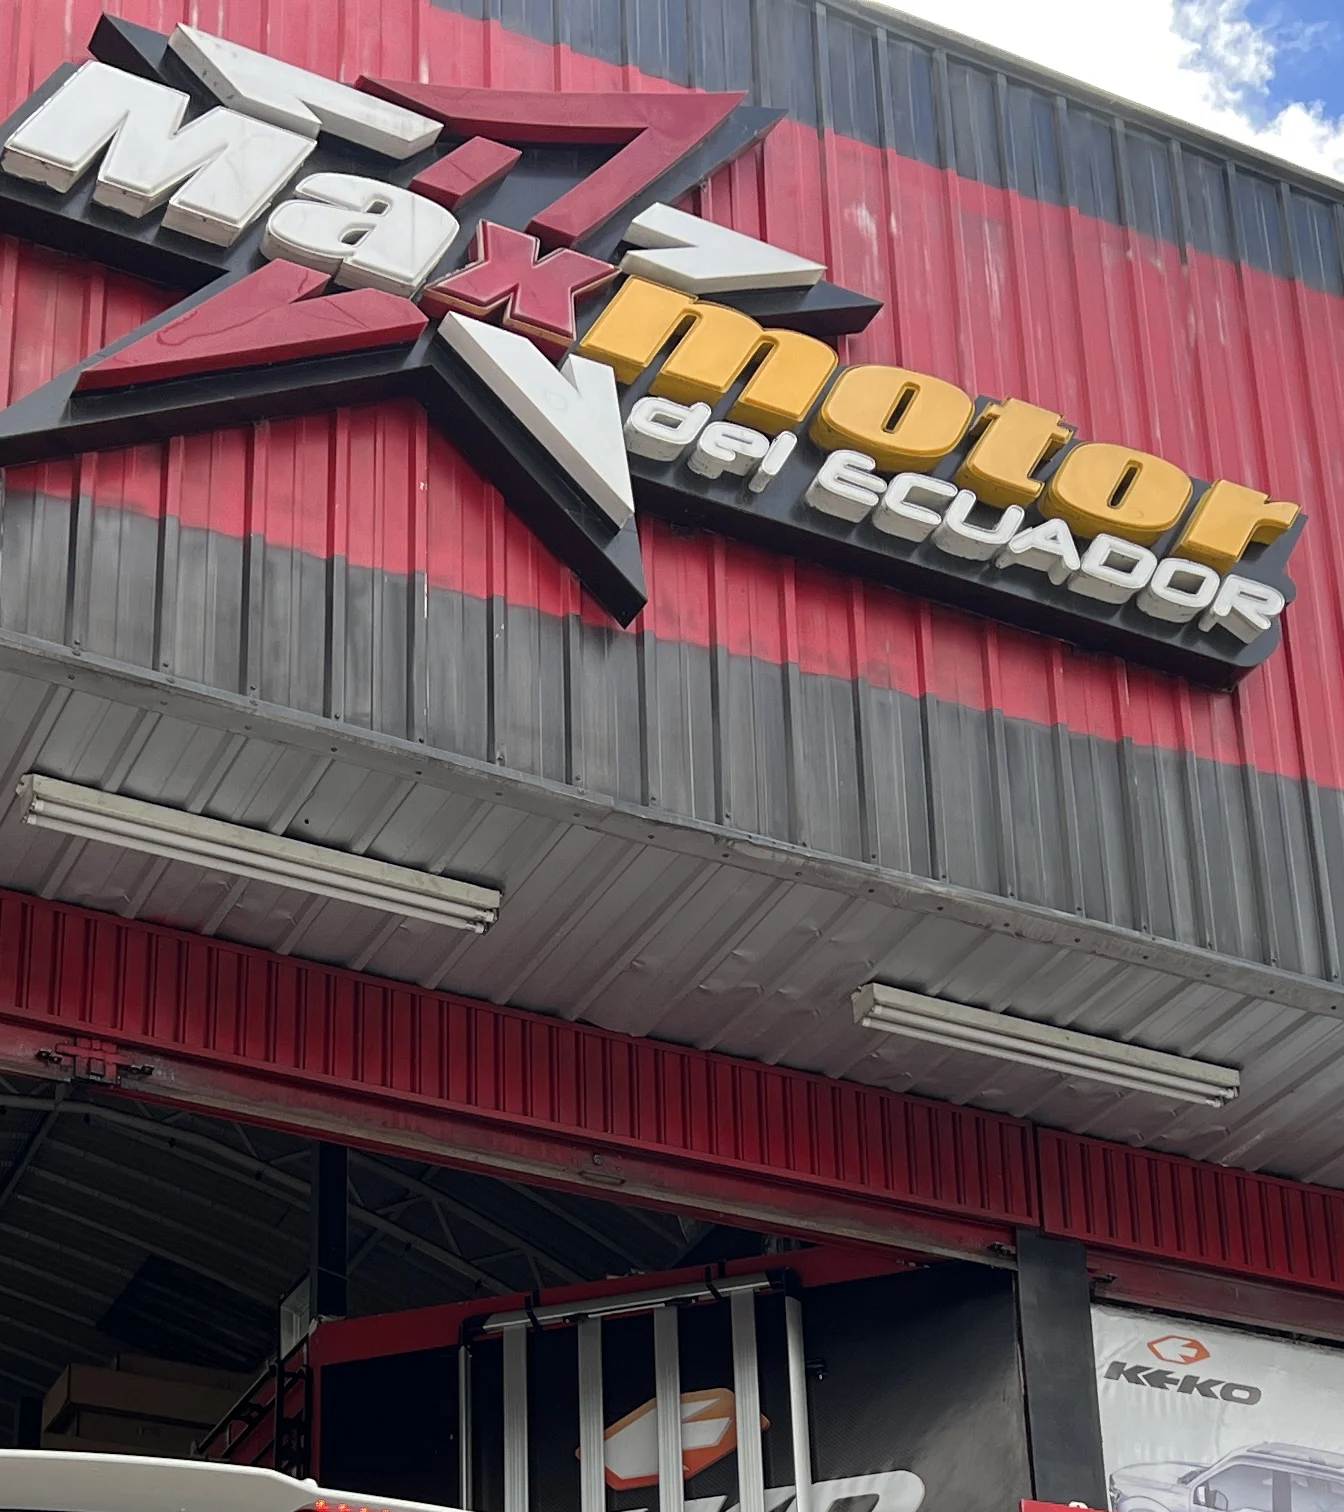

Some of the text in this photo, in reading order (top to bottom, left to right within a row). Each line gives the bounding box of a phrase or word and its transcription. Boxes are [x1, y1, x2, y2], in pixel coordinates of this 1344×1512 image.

[623, 396, 1286, 643] del ECUADOR
[1103, 1361, 1262, 1405] KEKO
